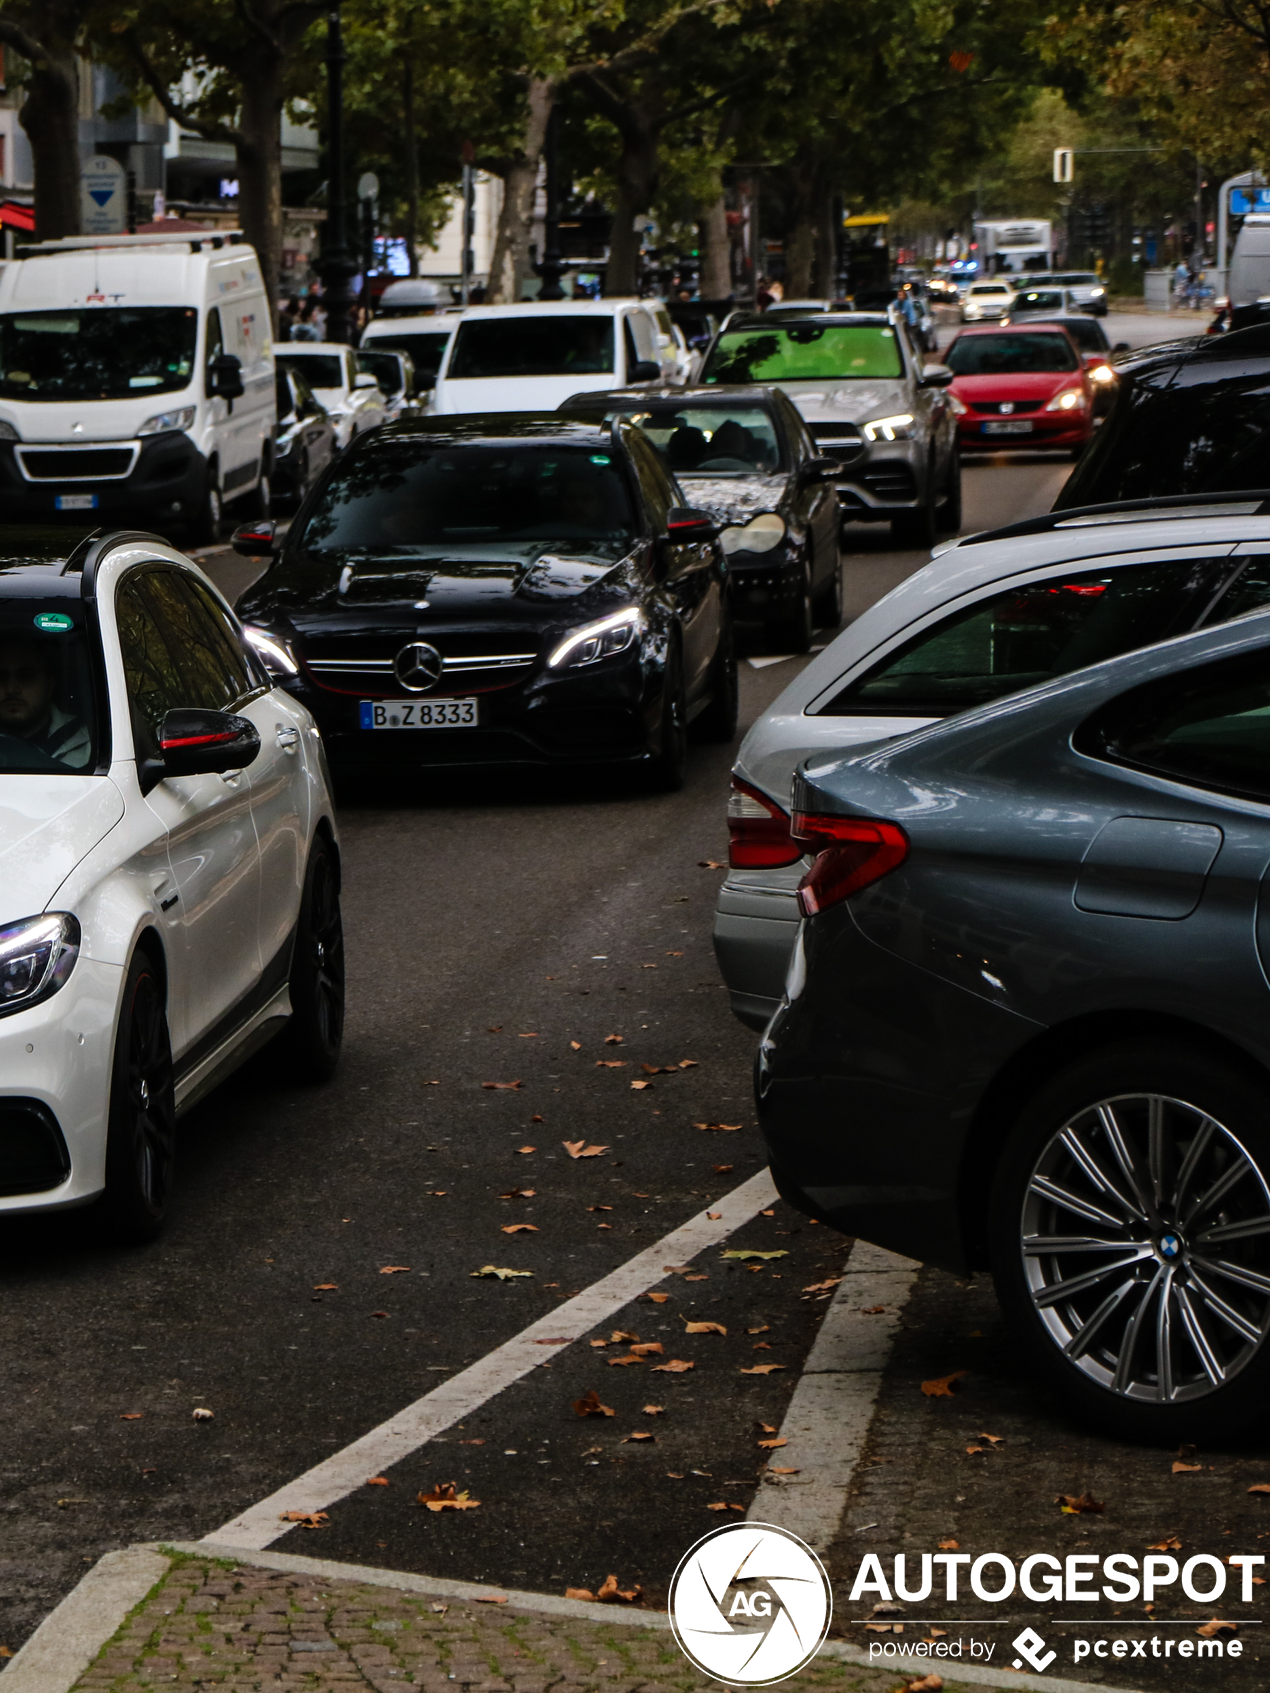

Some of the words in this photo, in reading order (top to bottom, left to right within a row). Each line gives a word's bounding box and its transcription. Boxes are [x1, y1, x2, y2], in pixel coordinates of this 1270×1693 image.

[373, 705, 387, 726] B
[401, 705, 415, 726] Z
[420, 703, 474, 725] 8333
